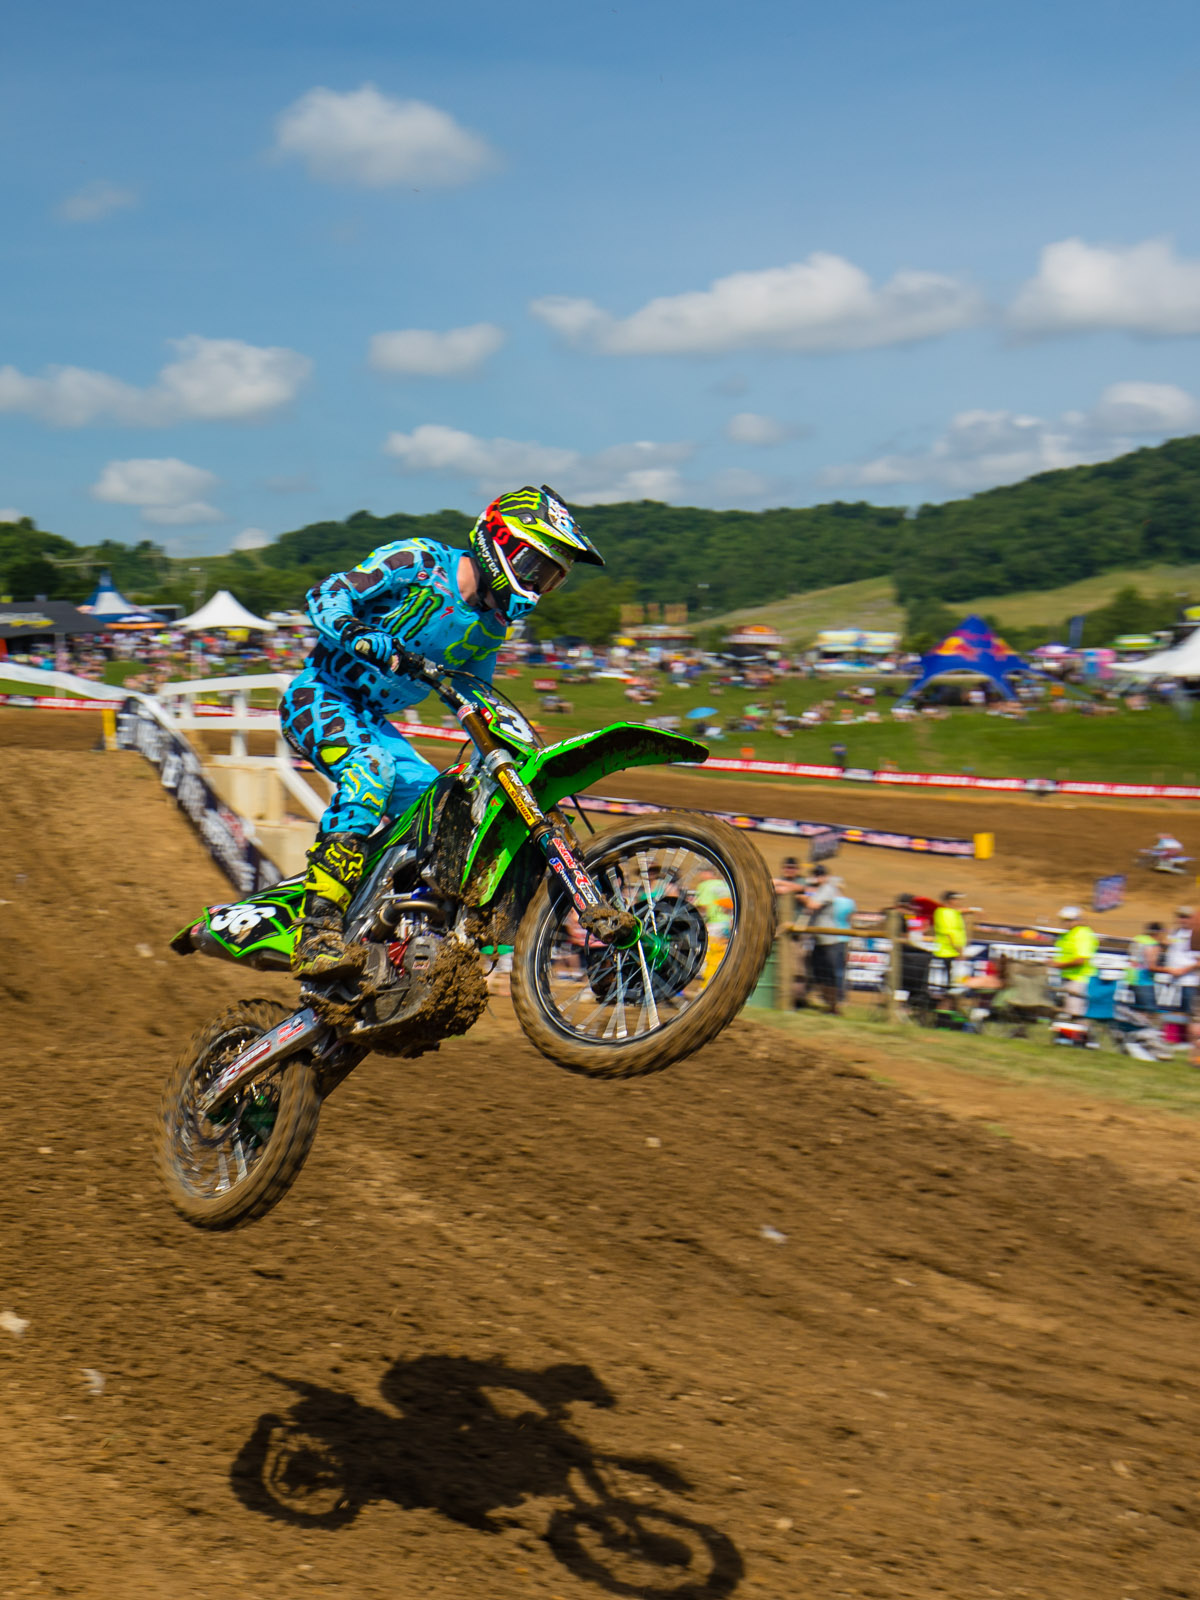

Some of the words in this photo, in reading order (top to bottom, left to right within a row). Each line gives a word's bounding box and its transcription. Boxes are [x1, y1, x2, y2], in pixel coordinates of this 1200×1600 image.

[476, 530, 500, 577] MONSTER
[511, 790, 531, 821] SHOWA
[210, 904, 277, 935] 36
